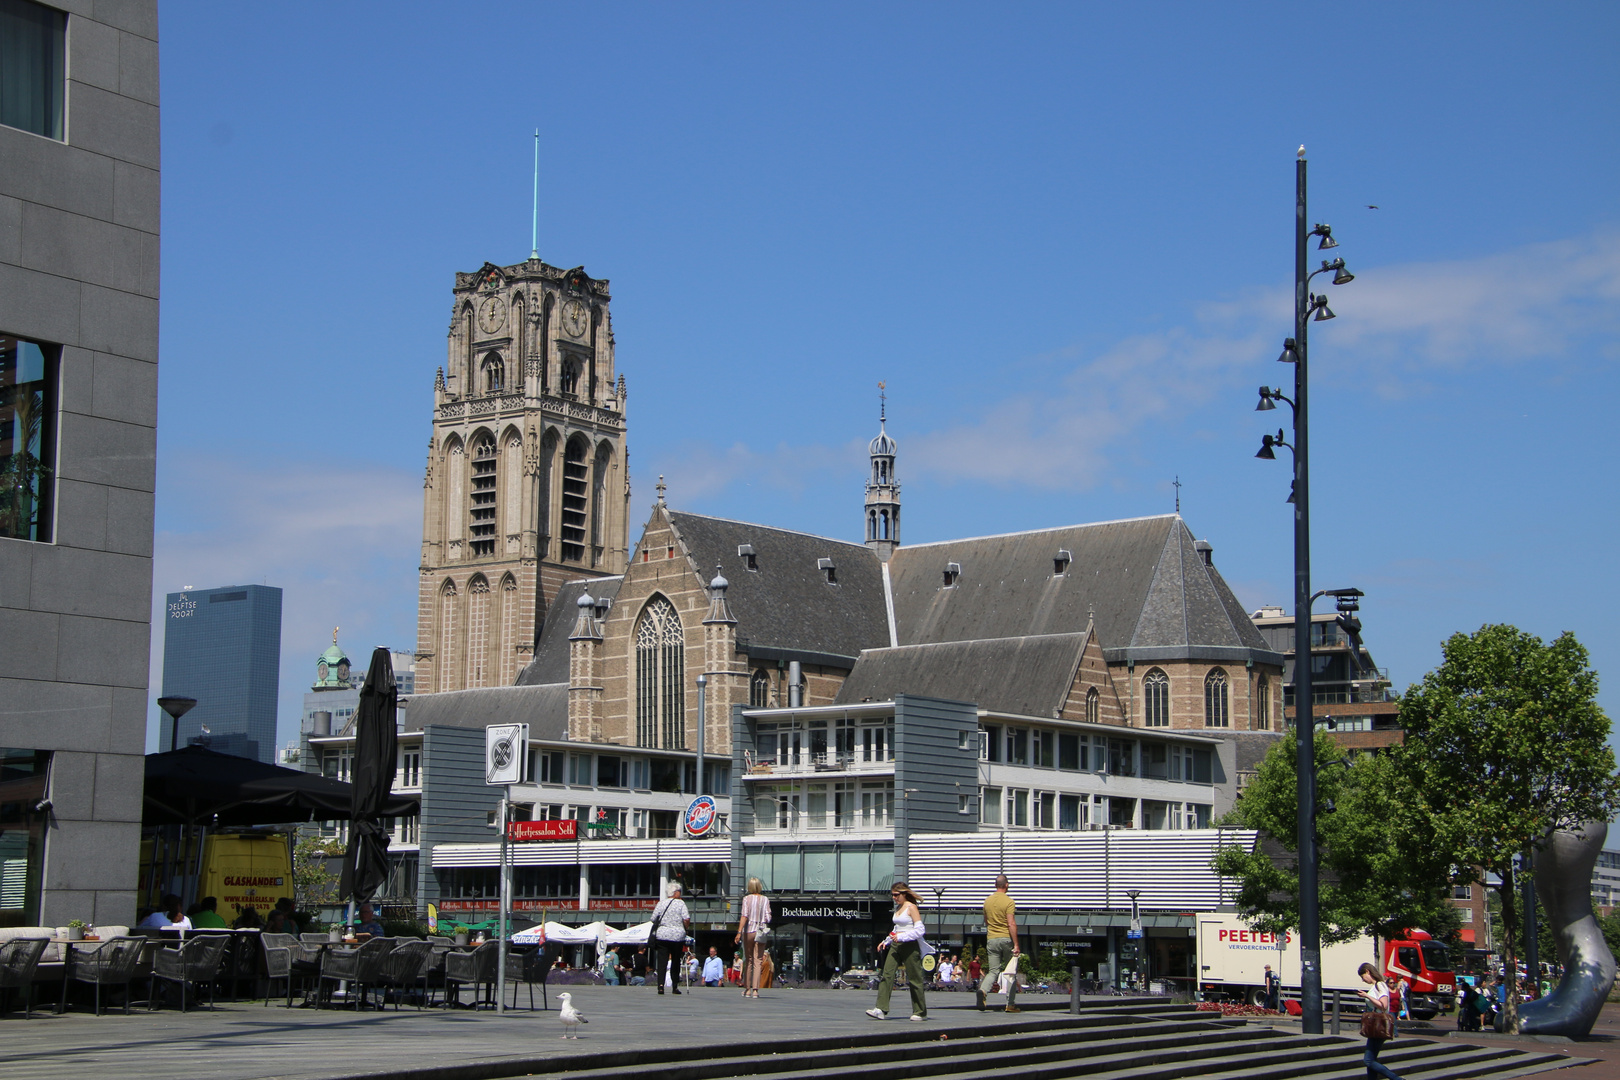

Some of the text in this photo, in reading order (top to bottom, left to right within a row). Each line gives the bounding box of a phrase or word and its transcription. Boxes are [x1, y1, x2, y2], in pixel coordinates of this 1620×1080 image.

[169, 601, 196, 611] DELFTSE
[171, 610, 194, 618] POORT
[558, 821, 575, 836] Seth
[782, 907, 858, 919] Boekhandel De Slegte
